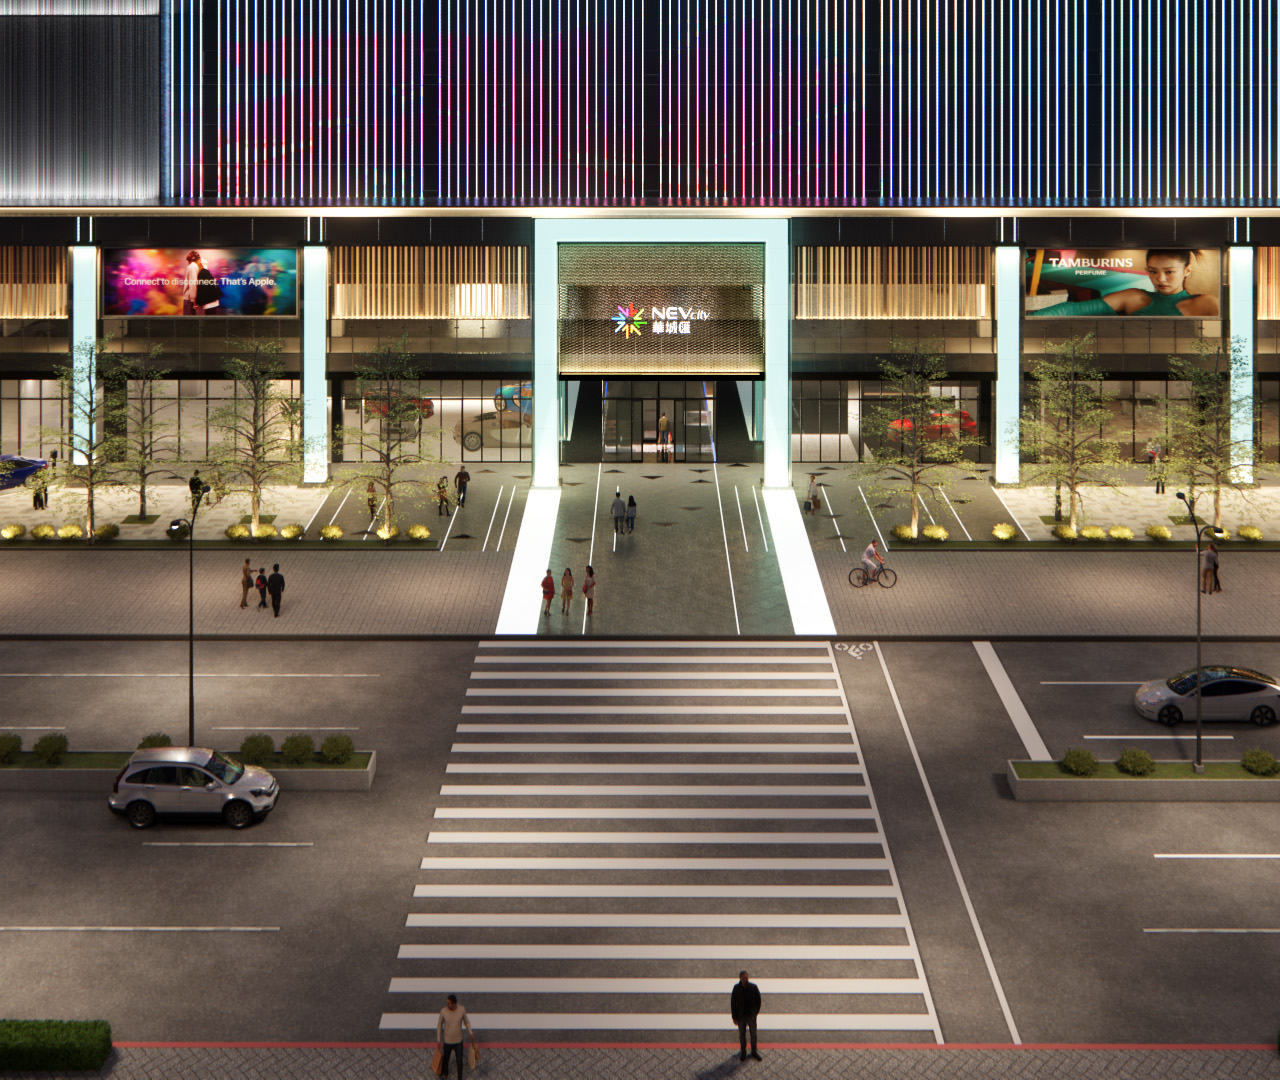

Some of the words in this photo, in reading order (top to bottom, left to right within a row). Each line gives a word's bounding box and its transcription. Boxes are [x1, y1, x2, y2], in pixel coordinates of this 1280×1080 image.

[1049, 257, 1133, 268] TAMBURINS
[124, 277, 159, 286] Connect
[160, 277, 170, 286] to
[171, 277, 219, 286] disconnect.
[248, 277, 277, 287] Apple.
[652, 321, 691, 335] 華城匯
